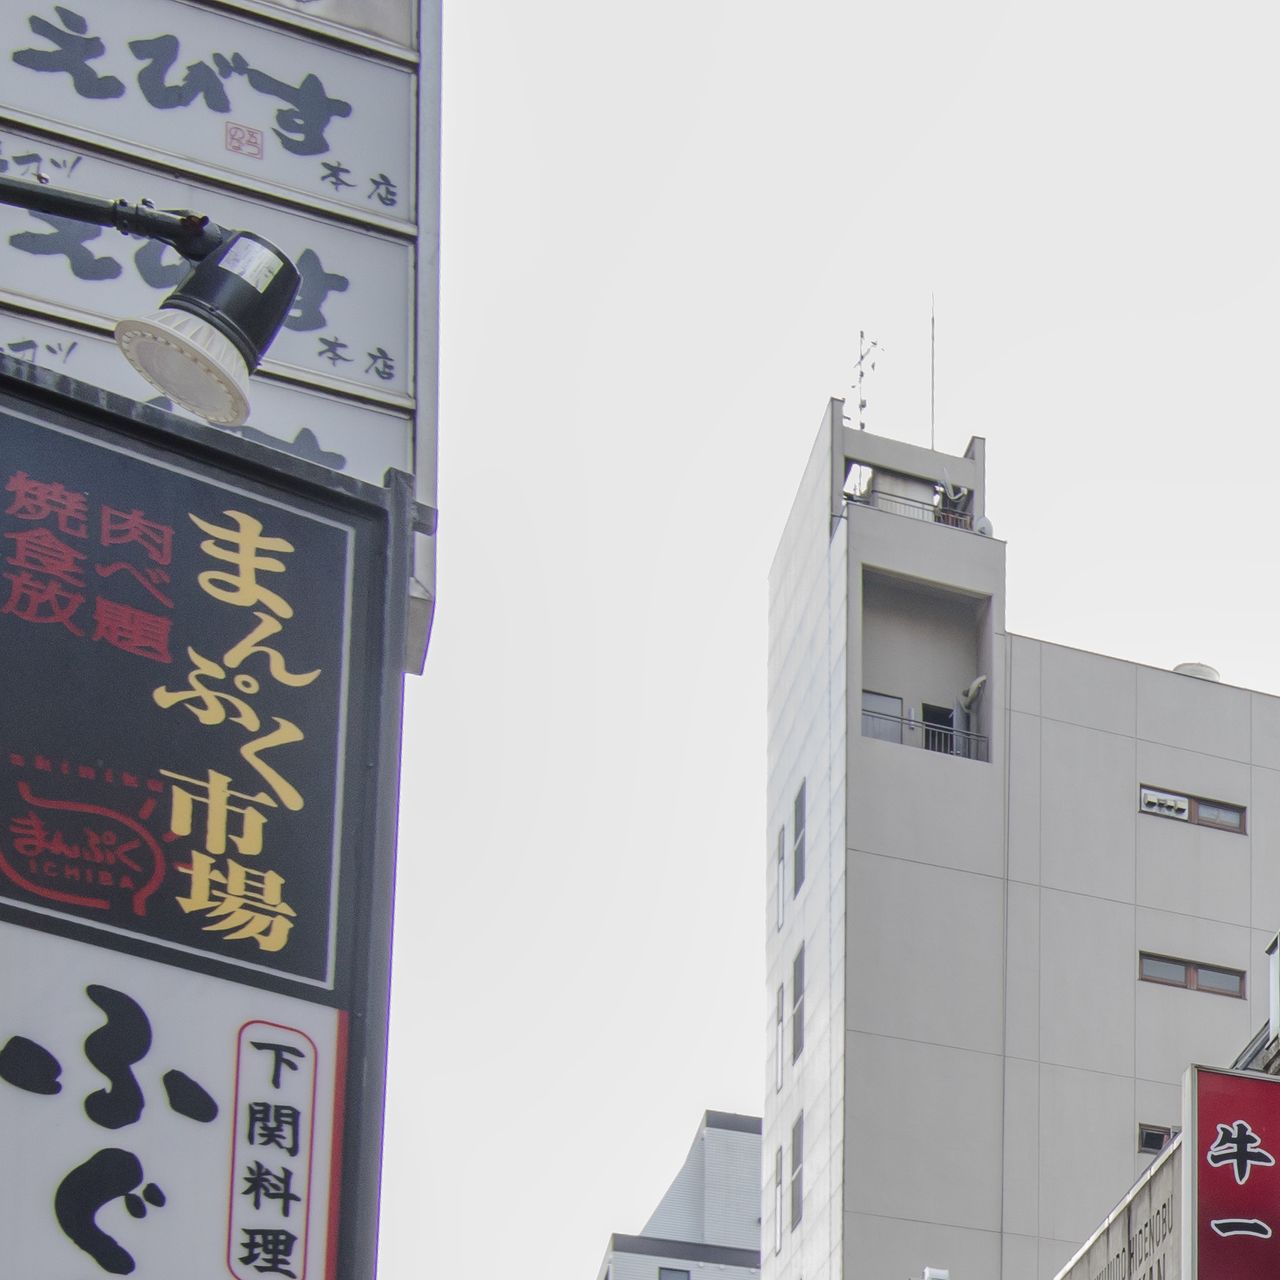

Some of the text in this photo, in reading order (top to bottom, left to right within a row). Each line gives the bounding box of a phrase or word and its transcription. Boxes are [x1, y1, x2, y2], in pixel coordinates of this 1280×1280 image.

[320, 161, 399, 207] 本店
[317, 336, 395, 380] 本店
[4, 471, 175, 566] 焼肉
[4, 527, 174, 608] 食べ
[1, 572, 173, 664] 放題
[152, 509, 321, 951] まんぷく市場
[238, 1041, 306, 1279] 下関料理
[1207, 1120, 1275, 1239] 牛一
